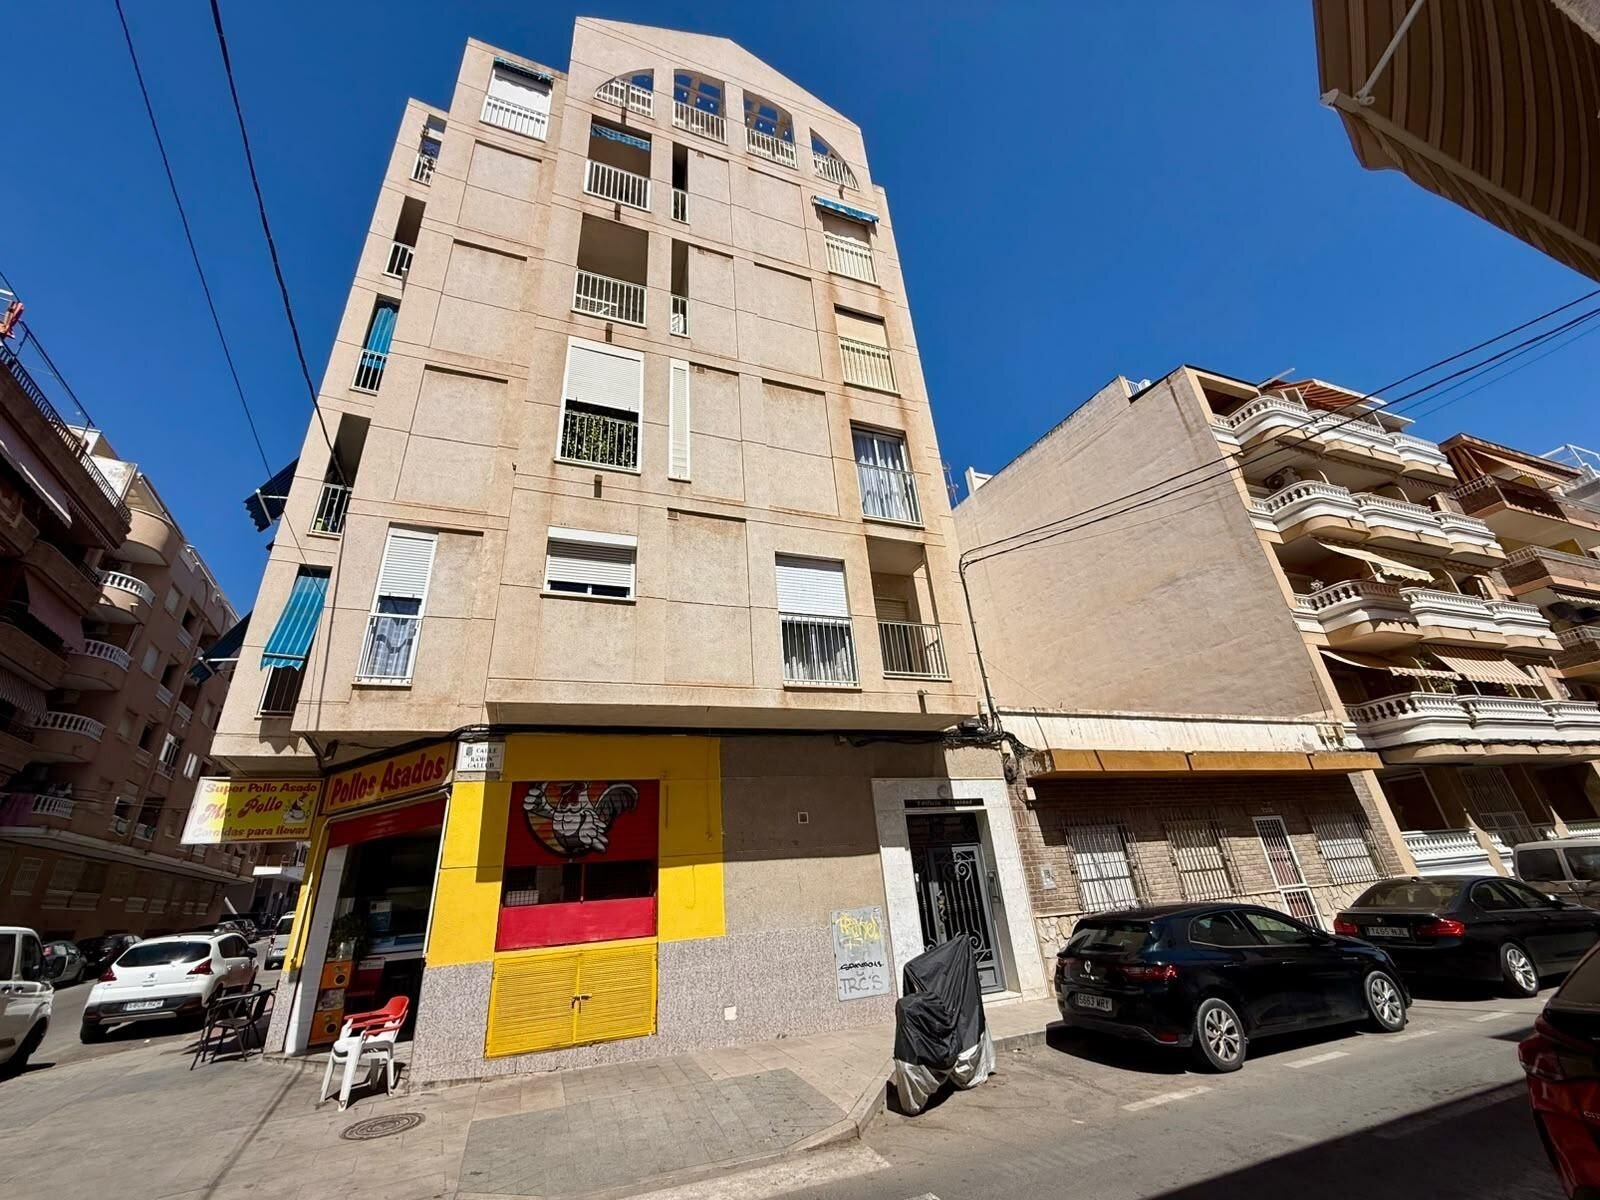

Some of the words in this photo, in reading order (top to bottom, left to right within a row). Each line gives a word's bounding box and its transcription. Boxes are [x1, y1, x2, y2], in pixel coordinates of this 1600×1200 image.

[204, 782, 247, 796] Super
[247, 783, 278, 793] Pollo
[279, 783, 318, 792] Asado
[329, 770, 377, 806] Pollos
[380, 751, 446, 793] Asados
[197, 803, 232, 825] Mr.
[237, 794, 284, 818] Pollo
[246, 827, 274, 838] para
[275, 826, 308, 835] llevar
